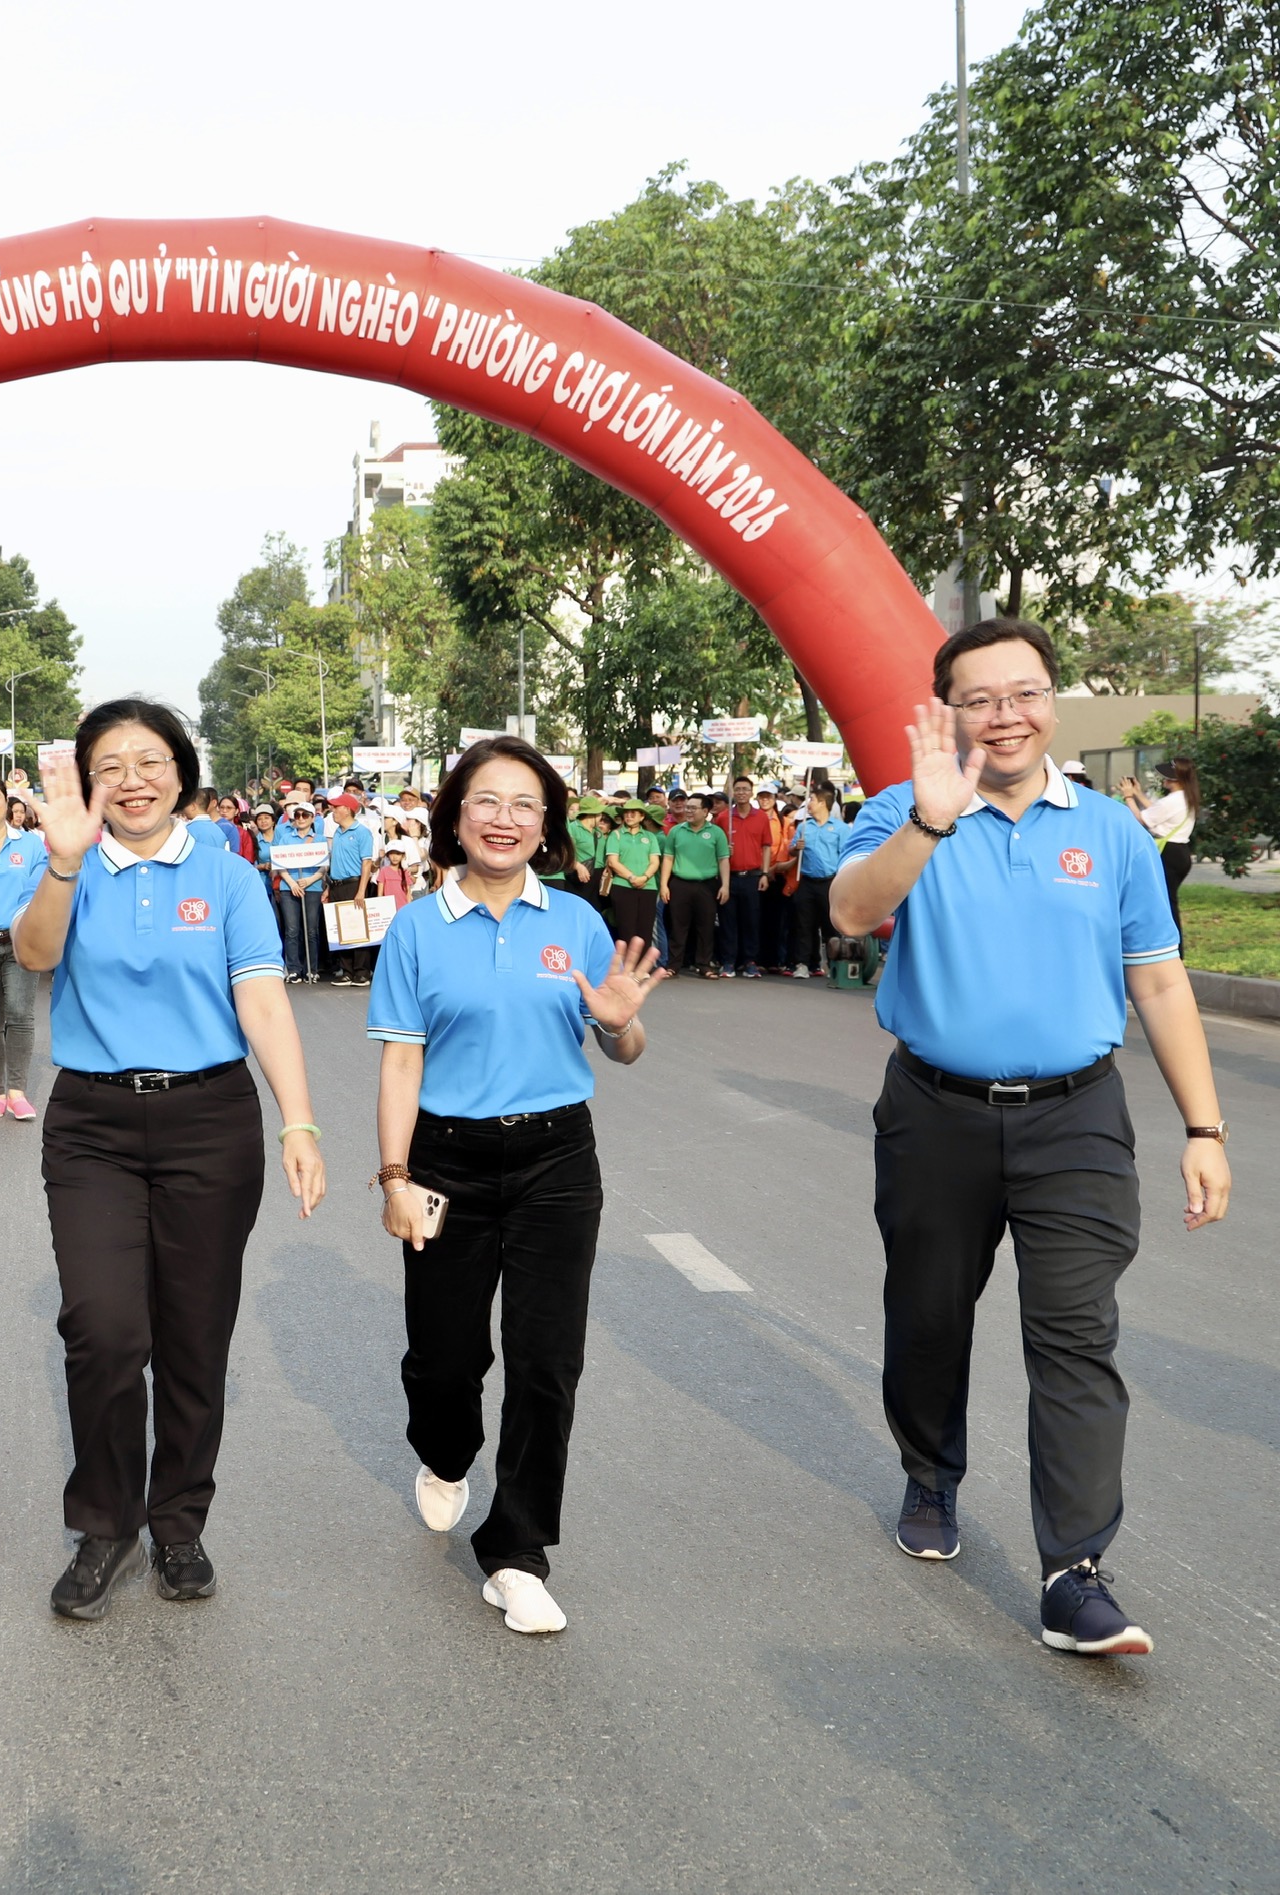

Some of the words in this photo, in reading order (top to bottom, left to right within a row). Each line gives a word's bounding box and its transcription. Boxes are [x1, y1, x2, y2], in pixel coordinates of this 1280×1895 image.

[57, 250, 103, 333] HỘ
[431, 309, 558, 394] PHƯỜNG
[554, 351, 630, 432] CHỢ
[608, 383, 682, 456] LỚN
[657, 418, 738, 496] NĂM
[707, 463, 790, 542] 2026
